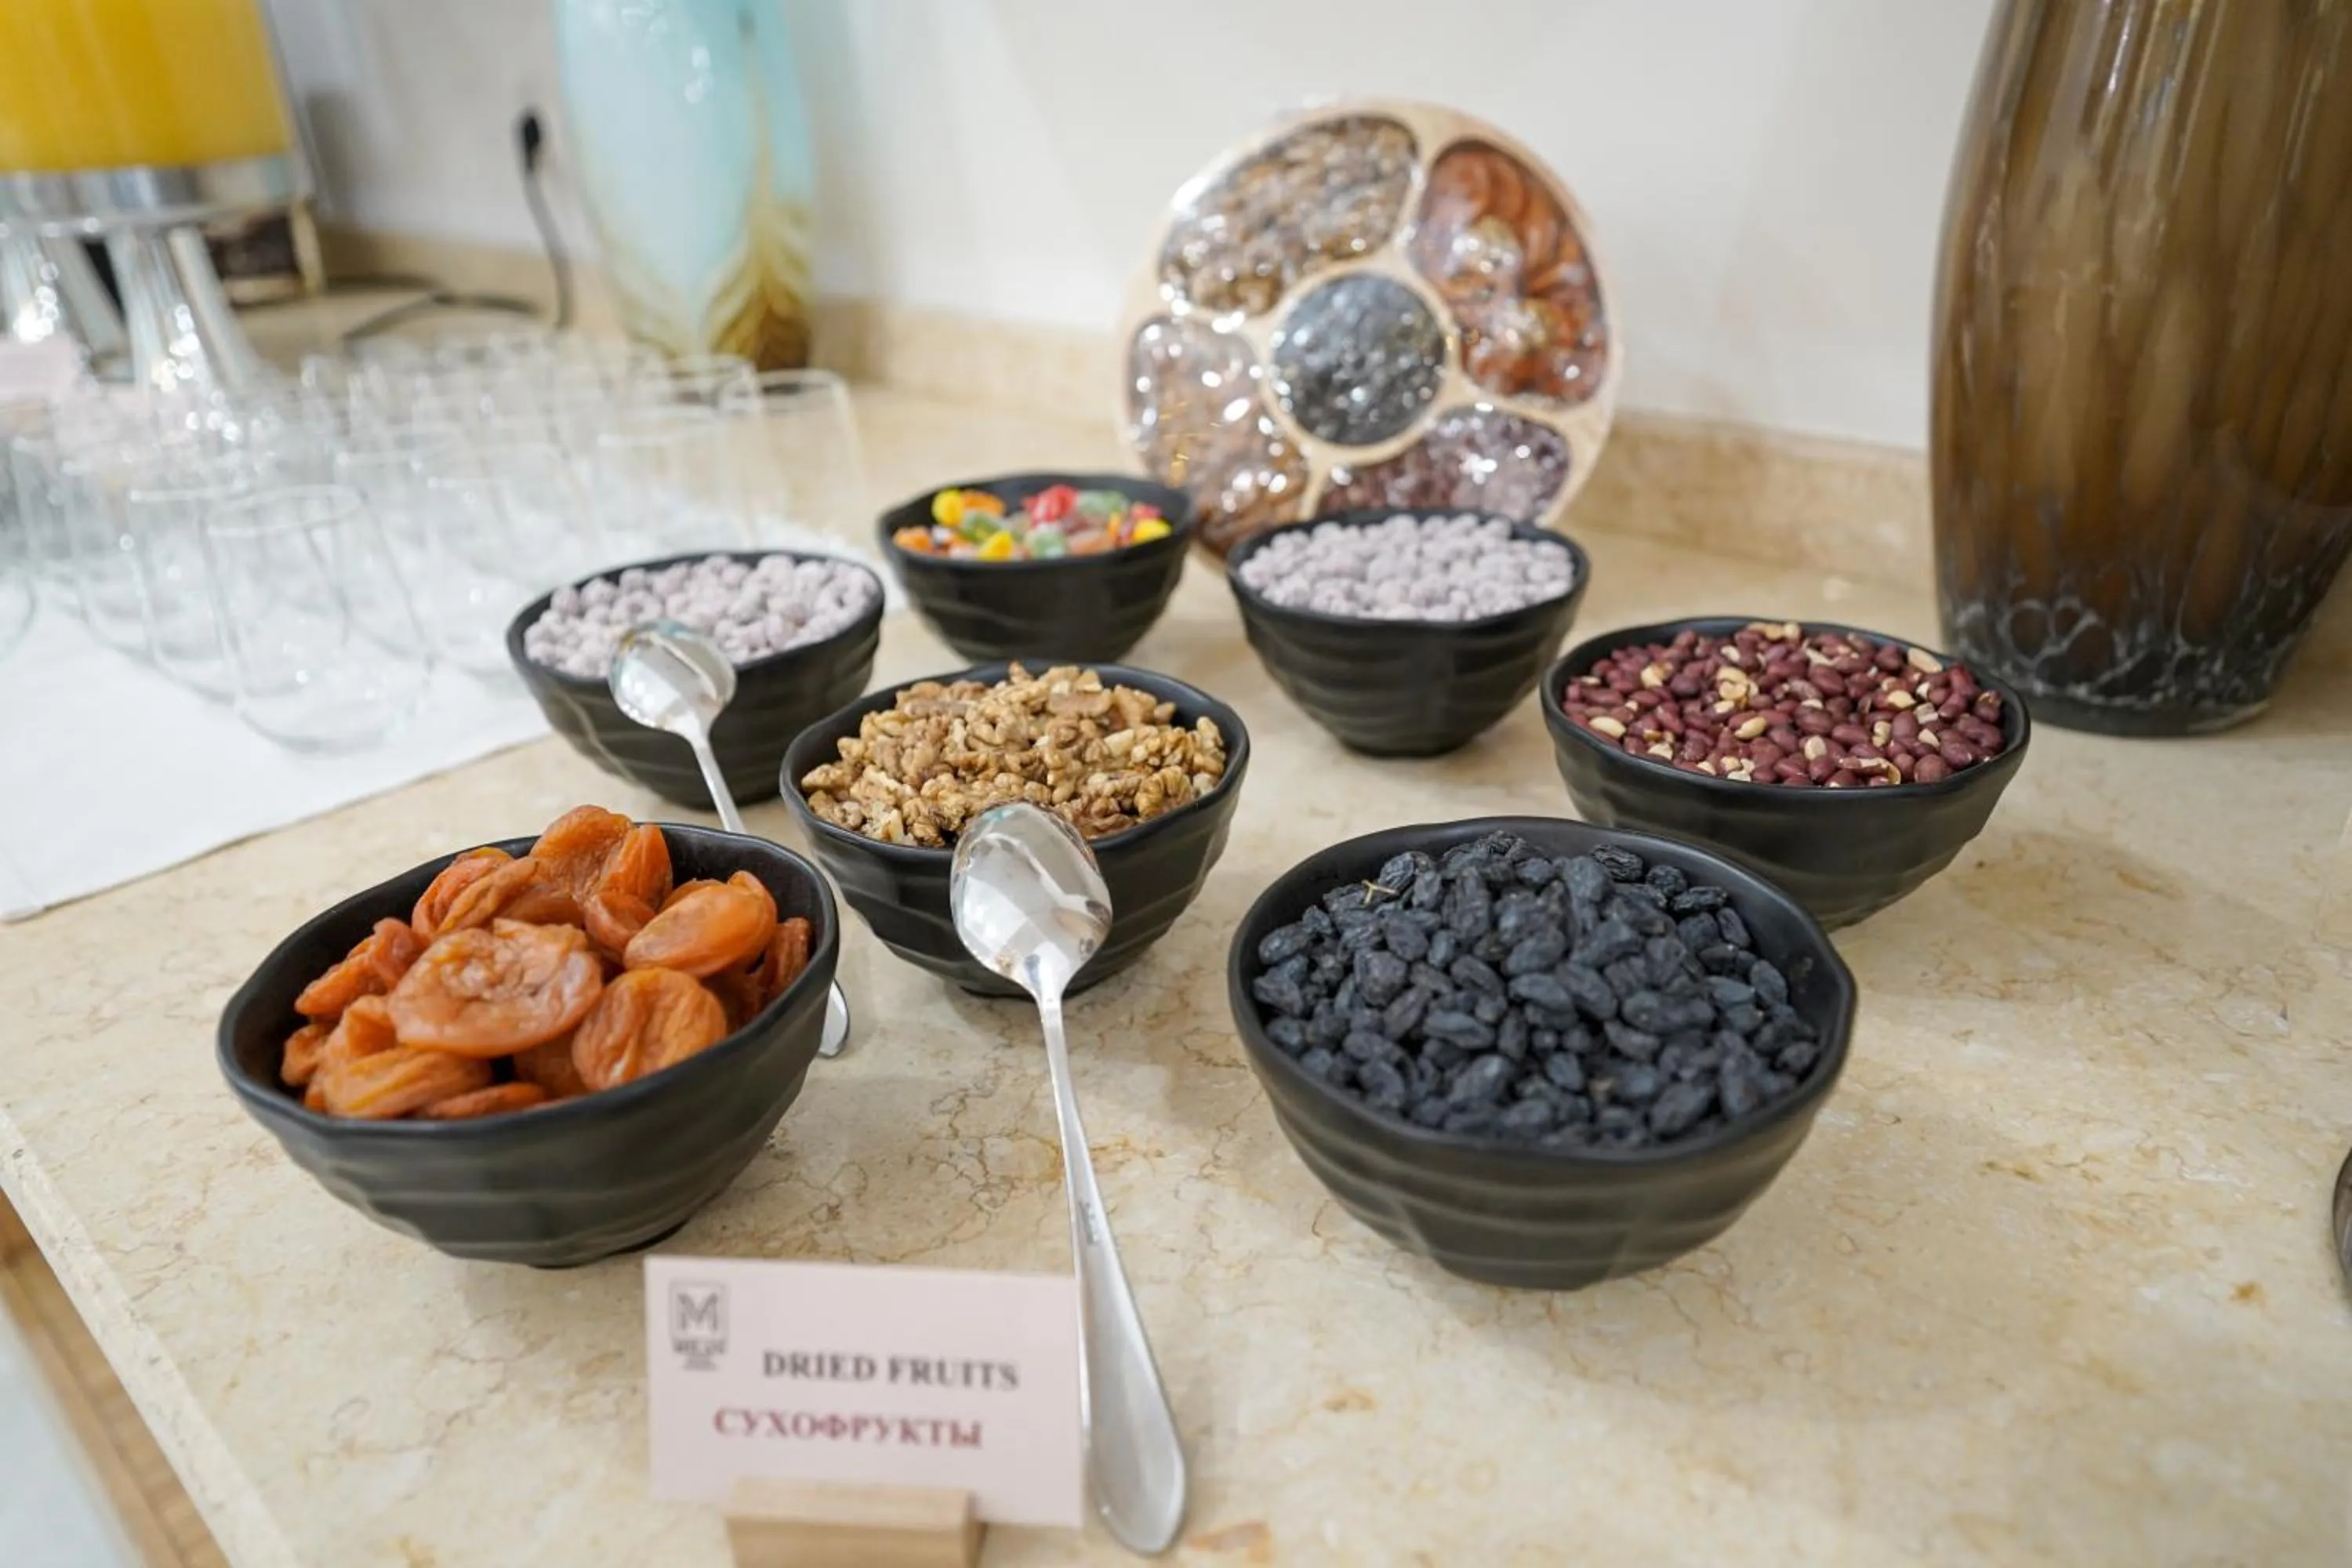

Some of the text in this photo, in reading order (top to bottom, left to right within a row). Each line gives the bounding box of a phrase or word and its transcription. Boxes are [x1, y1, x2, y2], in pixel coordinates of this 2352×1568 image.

[677, 1293, 718, 1330] M
[763, 1351, 1019, 1389] DRIED FRUITS
[713, 1407, 982, 1448] СУХОФРУКТЫ
